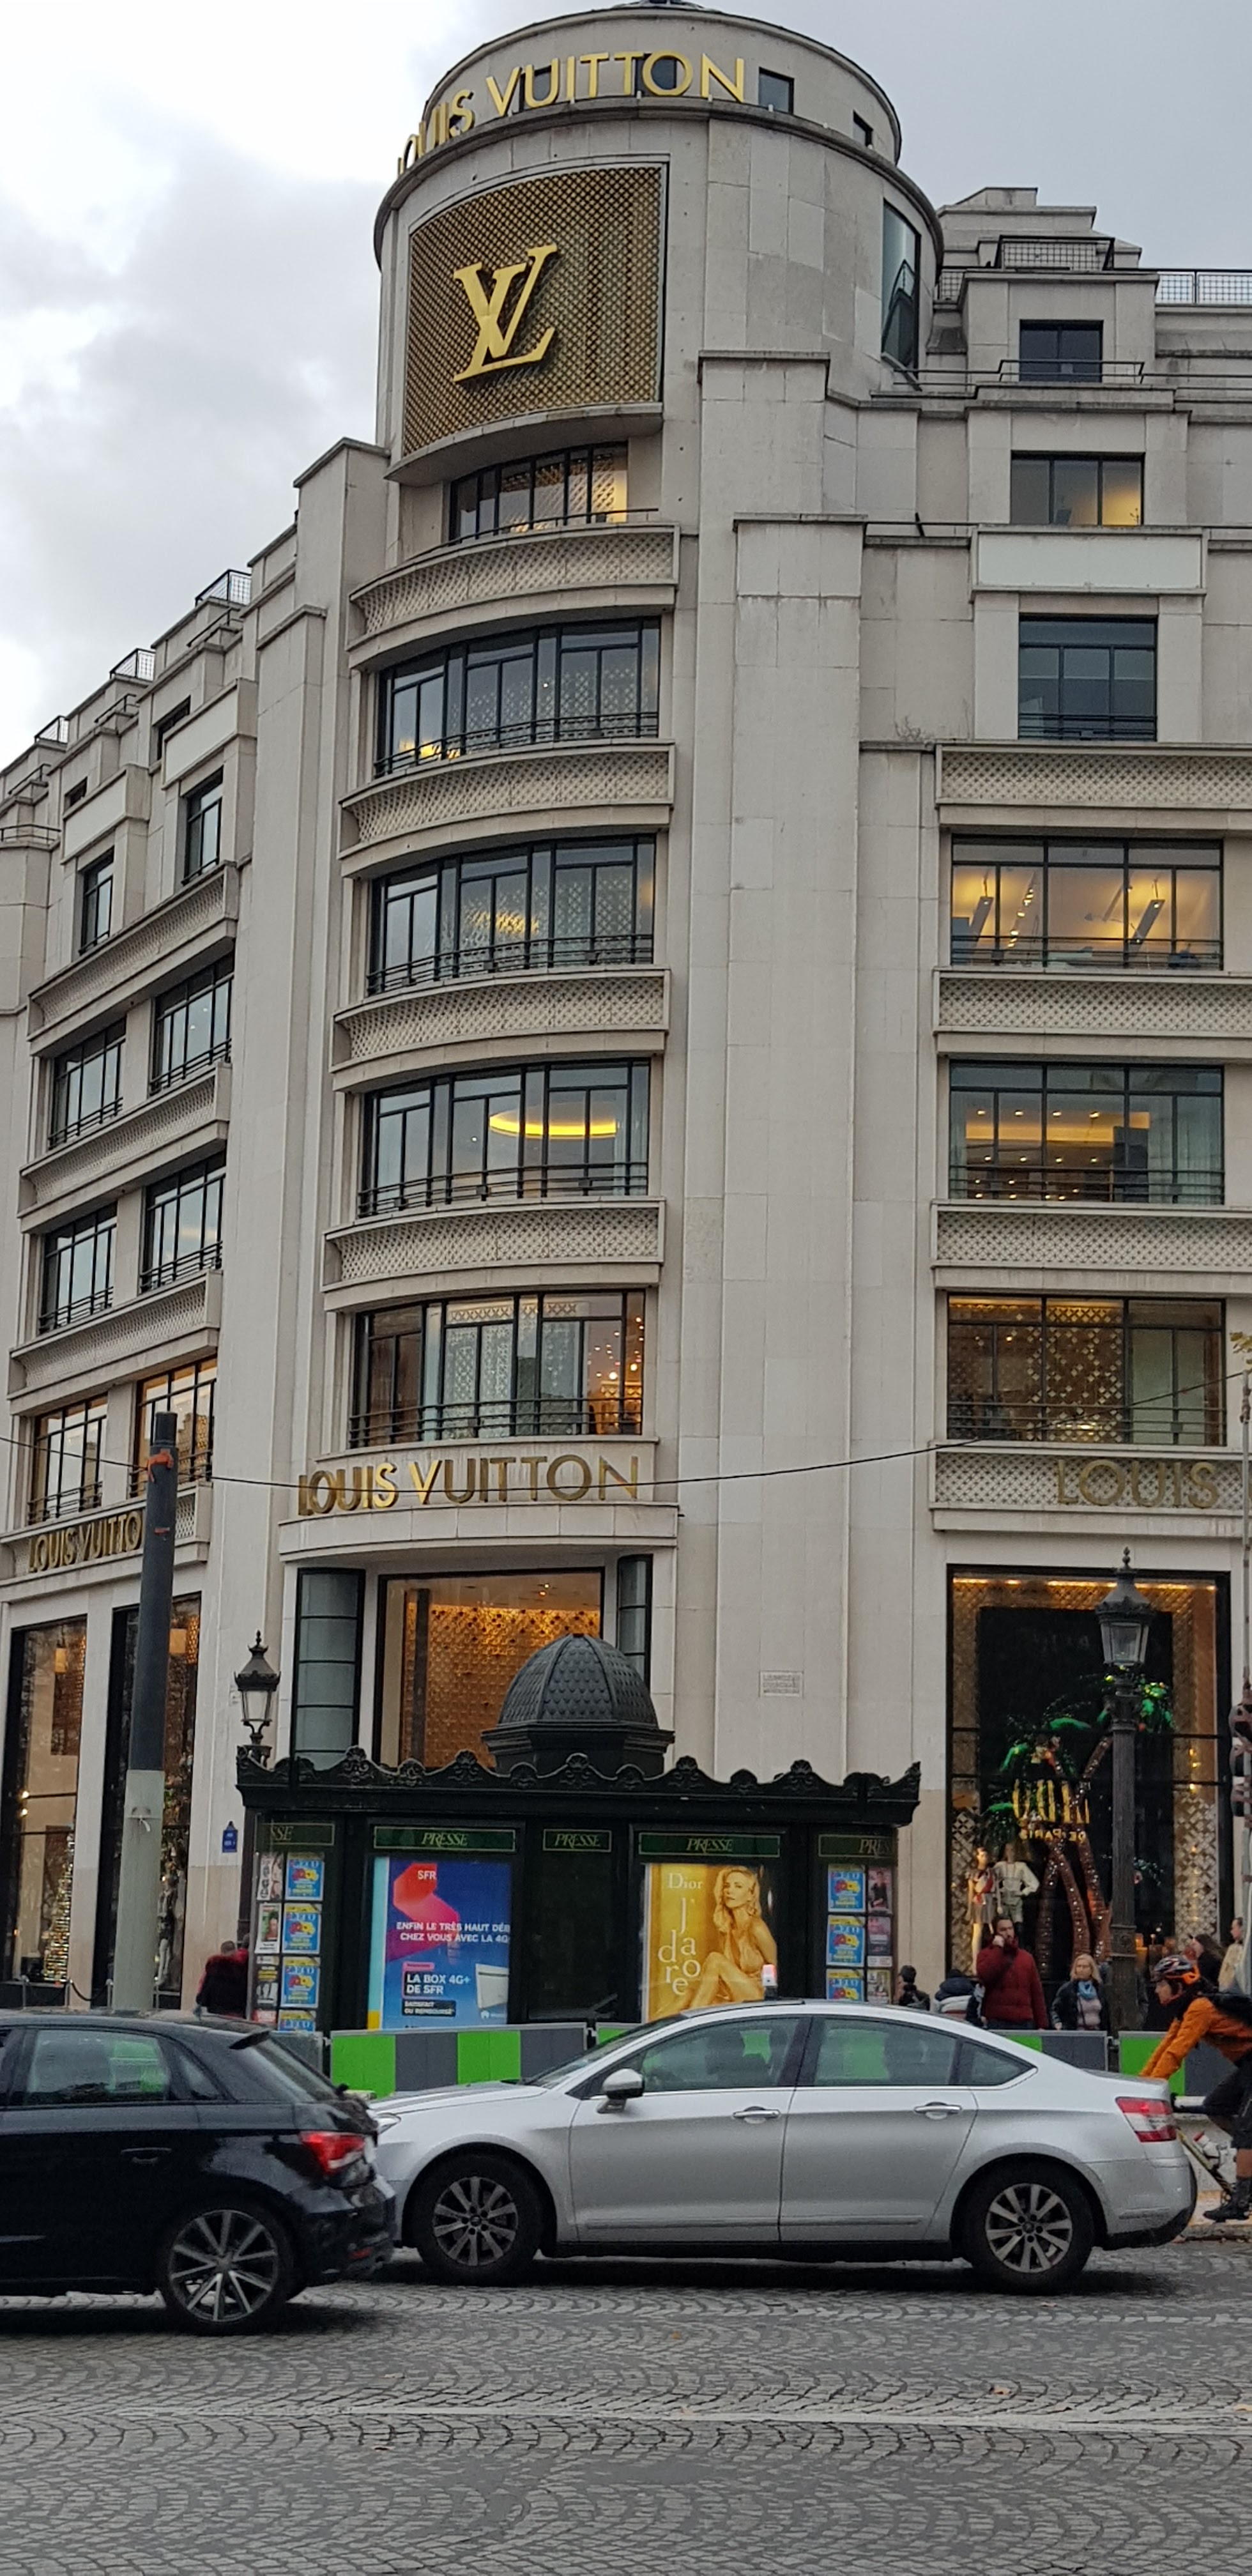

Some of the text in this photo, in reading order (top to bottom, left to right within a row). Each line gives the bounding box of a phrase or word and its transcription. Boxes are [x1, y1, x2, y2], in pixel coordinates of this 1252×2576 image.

[485, 49, 745, 117] VUITTON
[453, 243, 558, 383] LV
[298, 1454, 639, 1516] LOUIS VUITTON
[1057, 1459, 1219, 1509] LOUIS
[28, 1510, 146, 1574] LOUIS VUITTO
[421, 1832, 469, 1848] PRESSE
[554, 1833, 601, 1849] PRESSE
[685, 1837, 734, 1855] PRESSE
[417, 1870, 437, 1880] SFR
[668, 1872, 703, 1889] Dior
[396, 1920, 510, 1933] ENFIN LE TRÈS HAUT DÉB
[400, 1932, 425, 1941] CHEZ
[426, 1933, 452, 1942] VOUS
[454, 1933, 478, 1942] AVEC
[481, 1935, 492, 1943] LA
[406, 1973, 471, 1985] LA BOX 4G+
[406, 1984, 444, 1995] DE SFR
